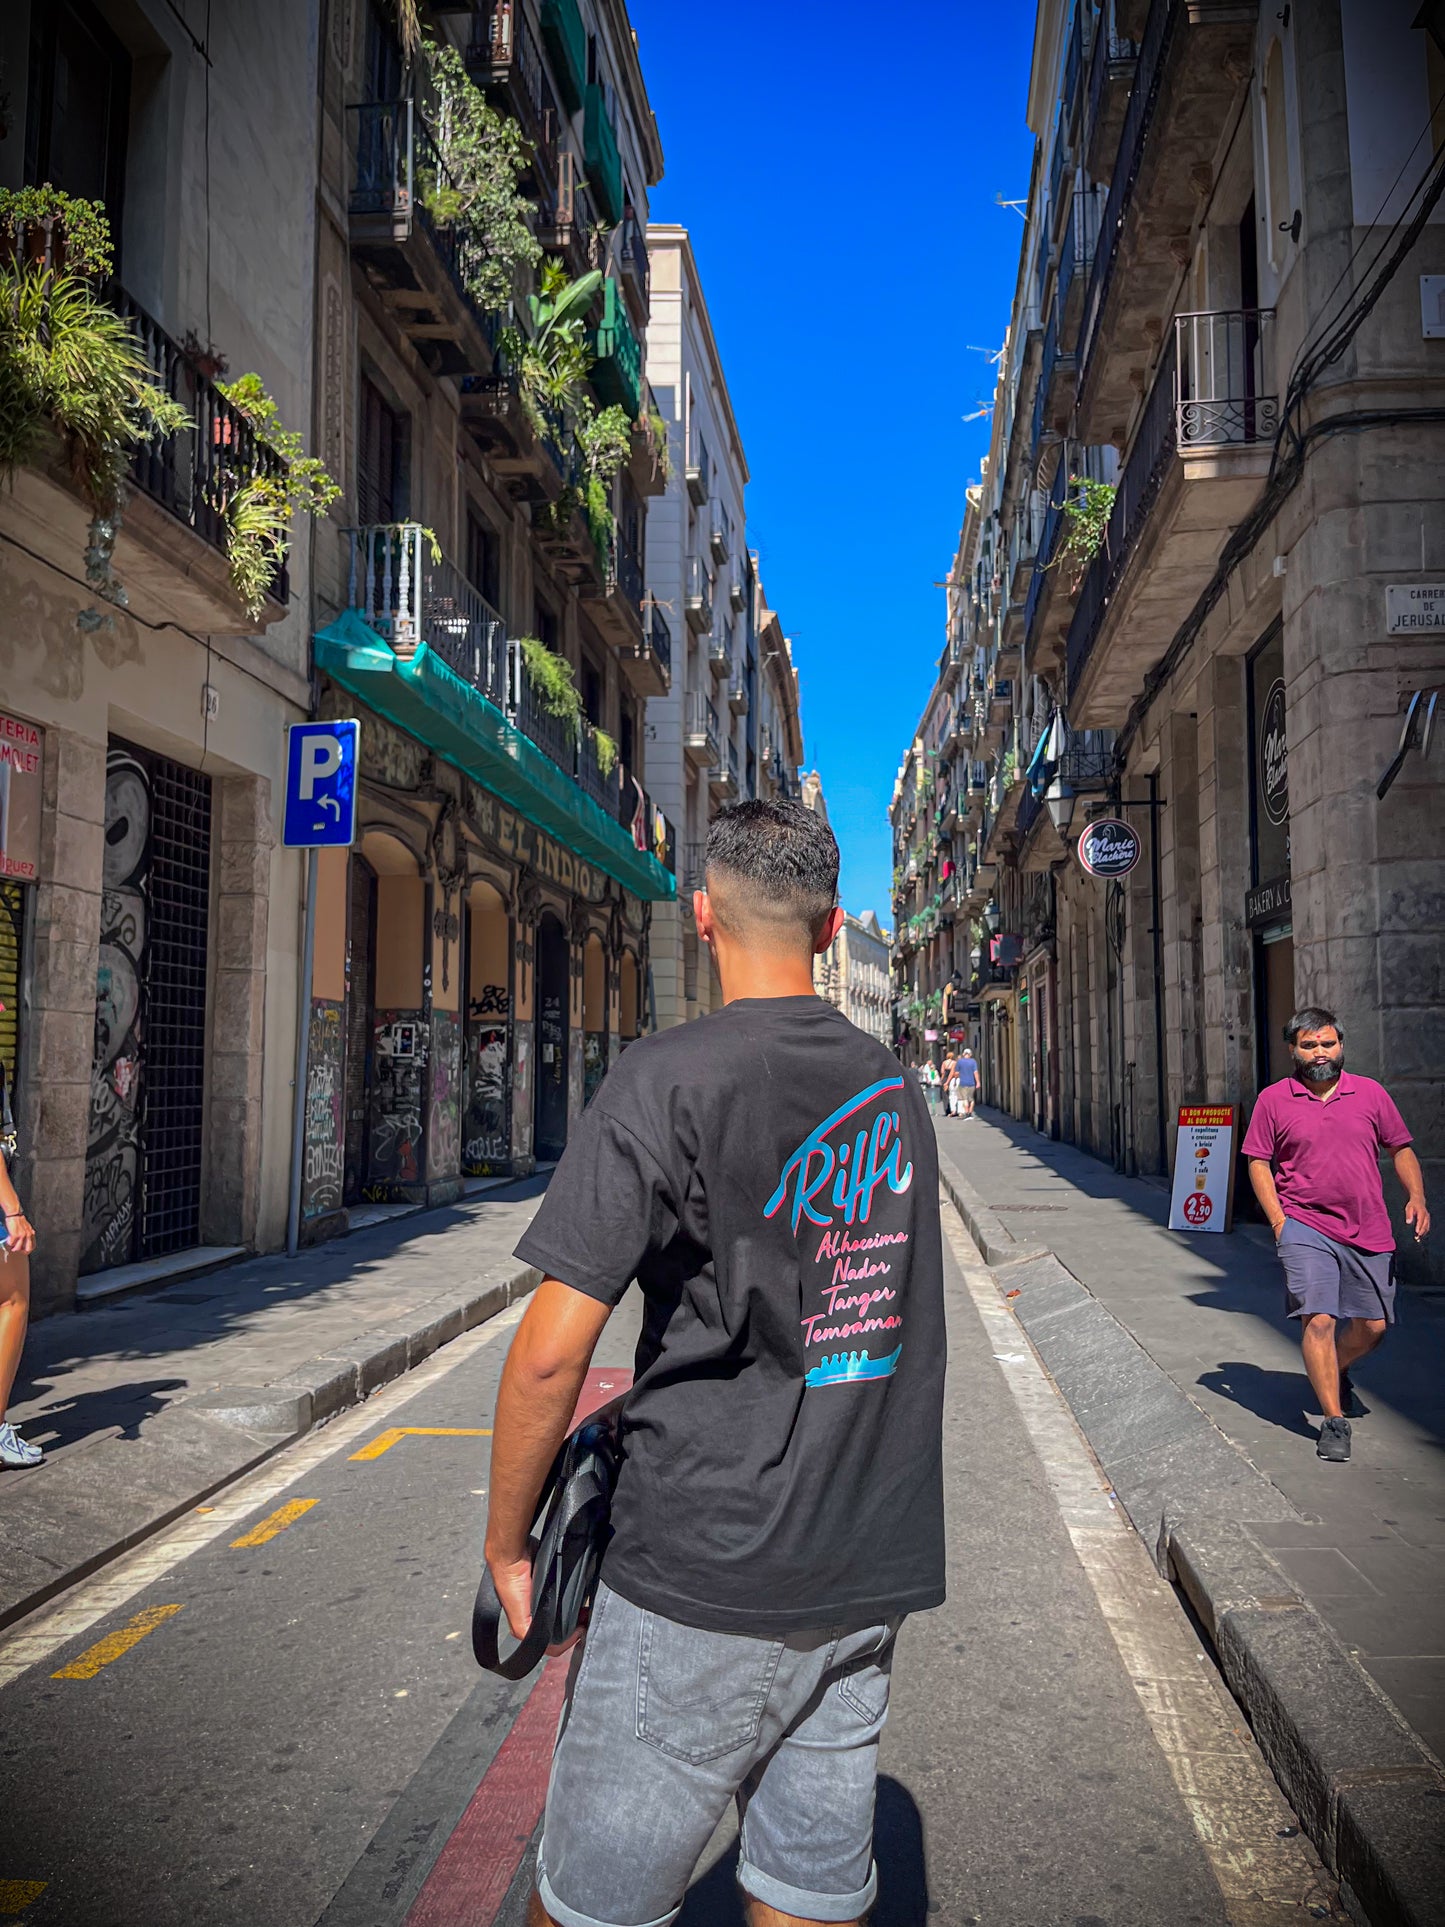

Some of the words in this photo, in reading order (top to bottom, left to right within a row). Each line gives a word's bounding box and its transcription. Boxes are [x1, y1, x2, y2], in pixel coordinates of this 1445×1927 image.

[1423, 601, 1435, 611] DE
[0, 743, 39, 775] MOLET
[299, 734, 343, 800] P
[499, 806, 531, 864] EL
[535, 832, 590, 898] INDIO
[1086, 837, 1135, 852] Marie
[1249, 885, 1275, 919] BAKERY
[544, 997, 560, 1008] 24
[1181, 1109, 1188, 1117] EL
[1202, 1107, 1231, 1116] PRODUCTE
[1187, 1117, 1194, 1125] AL
[1195, 1117, 1208, 1125] BON
[1208, 1117, 1224, 1125] PREU
[763, 1075, 913, 1238] Riffi
[832, 1256, 891, 1285] Nador
[821, 1283, 897, 1317] Tanger
[801, 1313, 903, 1348] Temsaman
